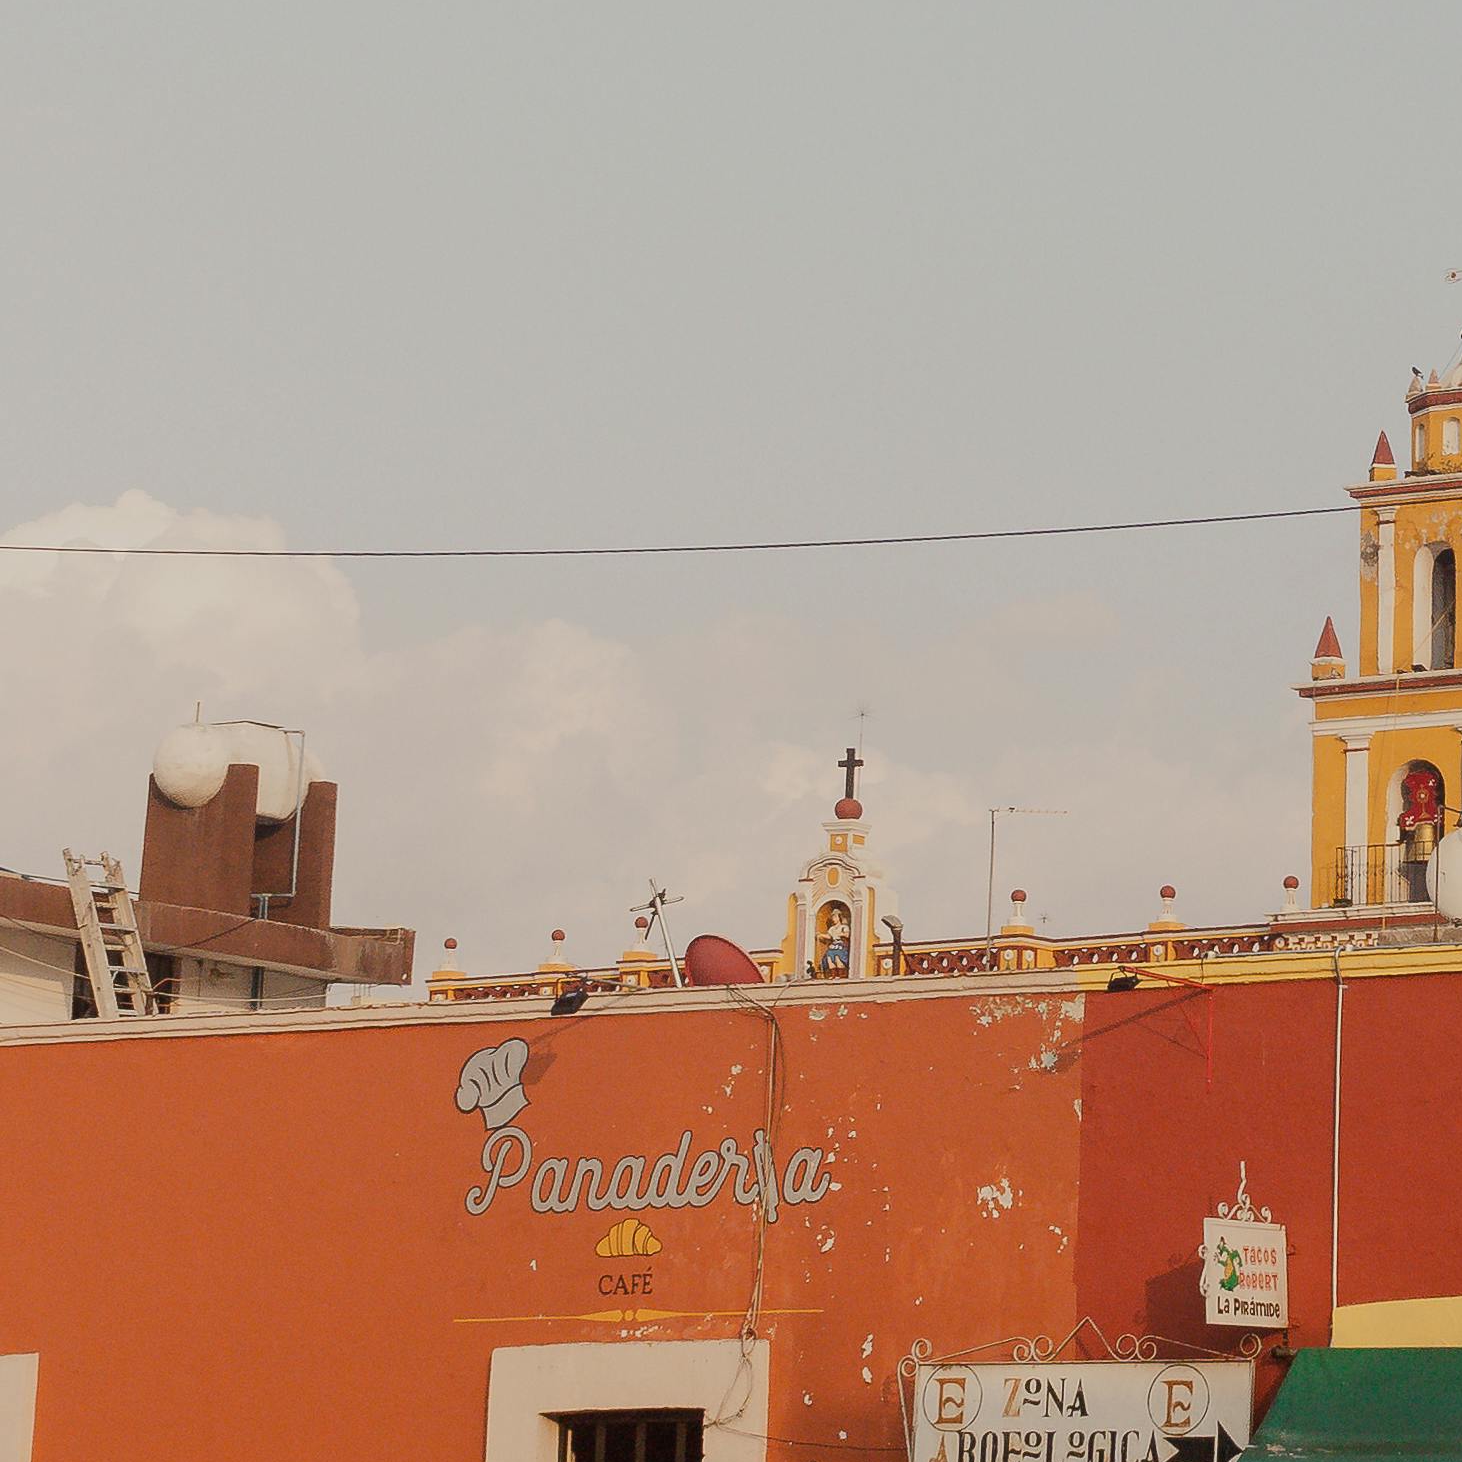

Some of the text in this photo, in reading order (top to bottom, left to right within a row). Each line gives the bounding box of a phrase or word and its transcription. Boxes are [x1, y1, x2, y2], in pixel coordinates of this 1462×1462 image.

[1243, 1246, 1277, 1266] TACOS
[598, 1267, 654, 1296] CAFÉ
[1239, 1270, 1279, 1291] ROBERT
[1001, 1377, 1089, 1418] ZONA
